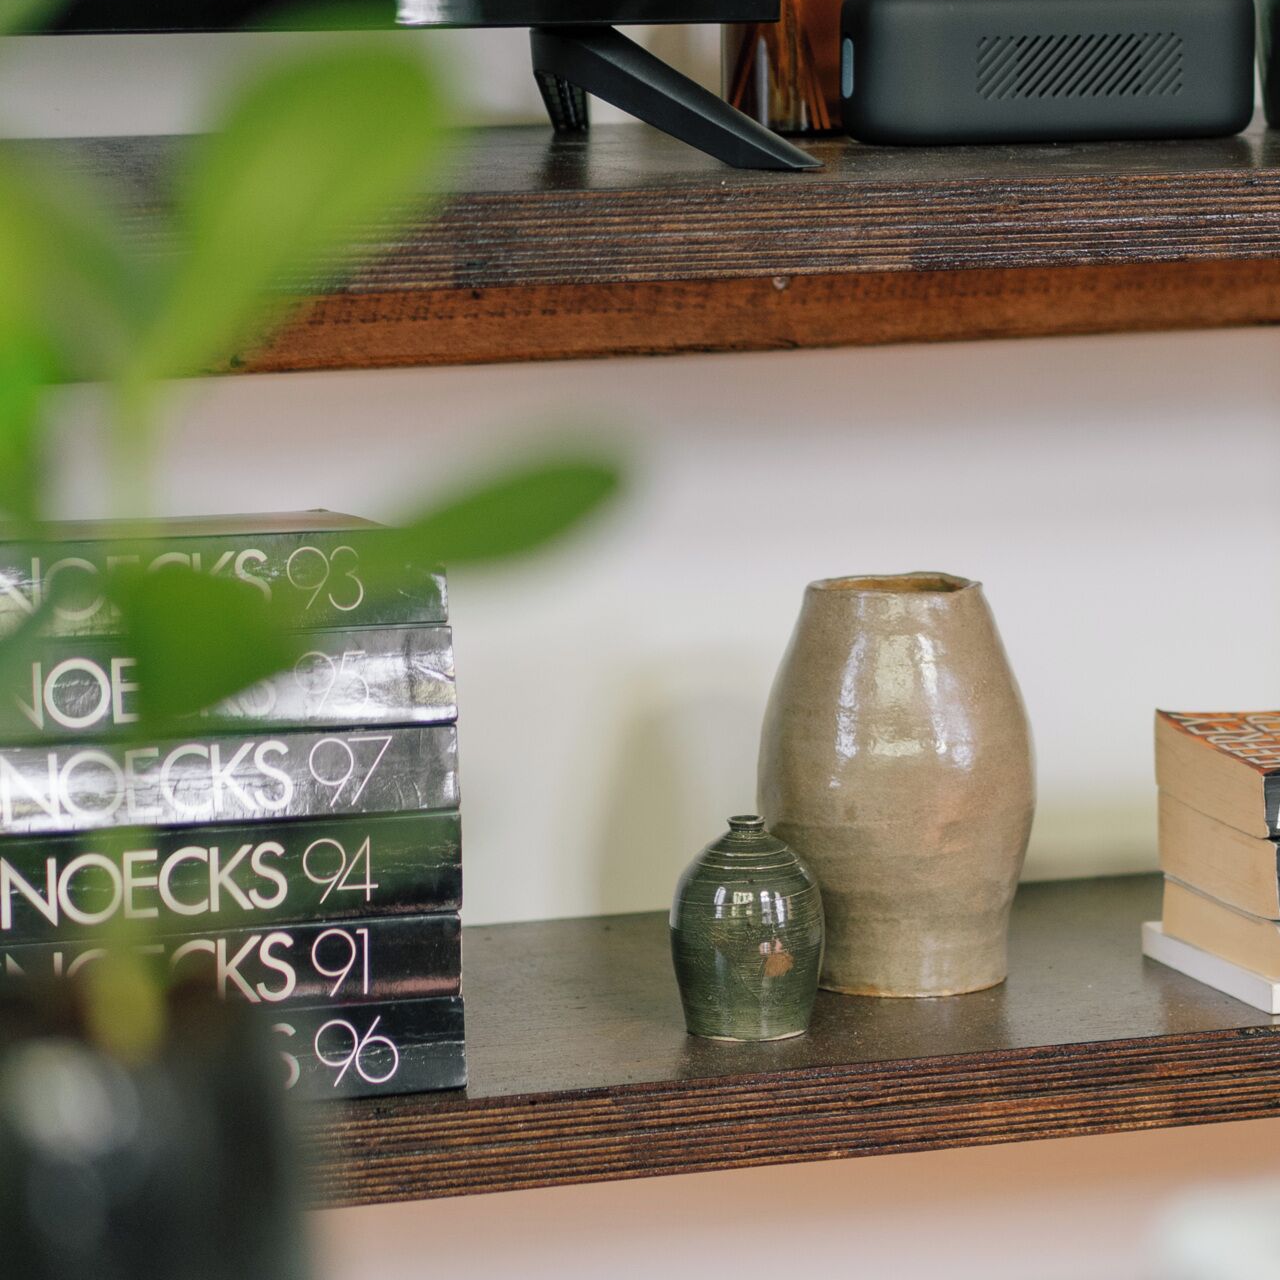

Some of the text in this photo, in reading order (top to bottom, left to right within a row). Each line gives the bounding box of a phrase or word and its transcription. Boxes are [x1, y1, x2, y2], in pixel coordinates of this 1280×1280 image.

[287, 546, 364, 611] 93
[295, 650, 369, 714] 95
[0, 736, 393, 828] NOECKS 97
[0, 835, 379, 930] NOECKS 94
[312, 928, 370, 998] 91
[315, 1015, 399, 1088] 96
